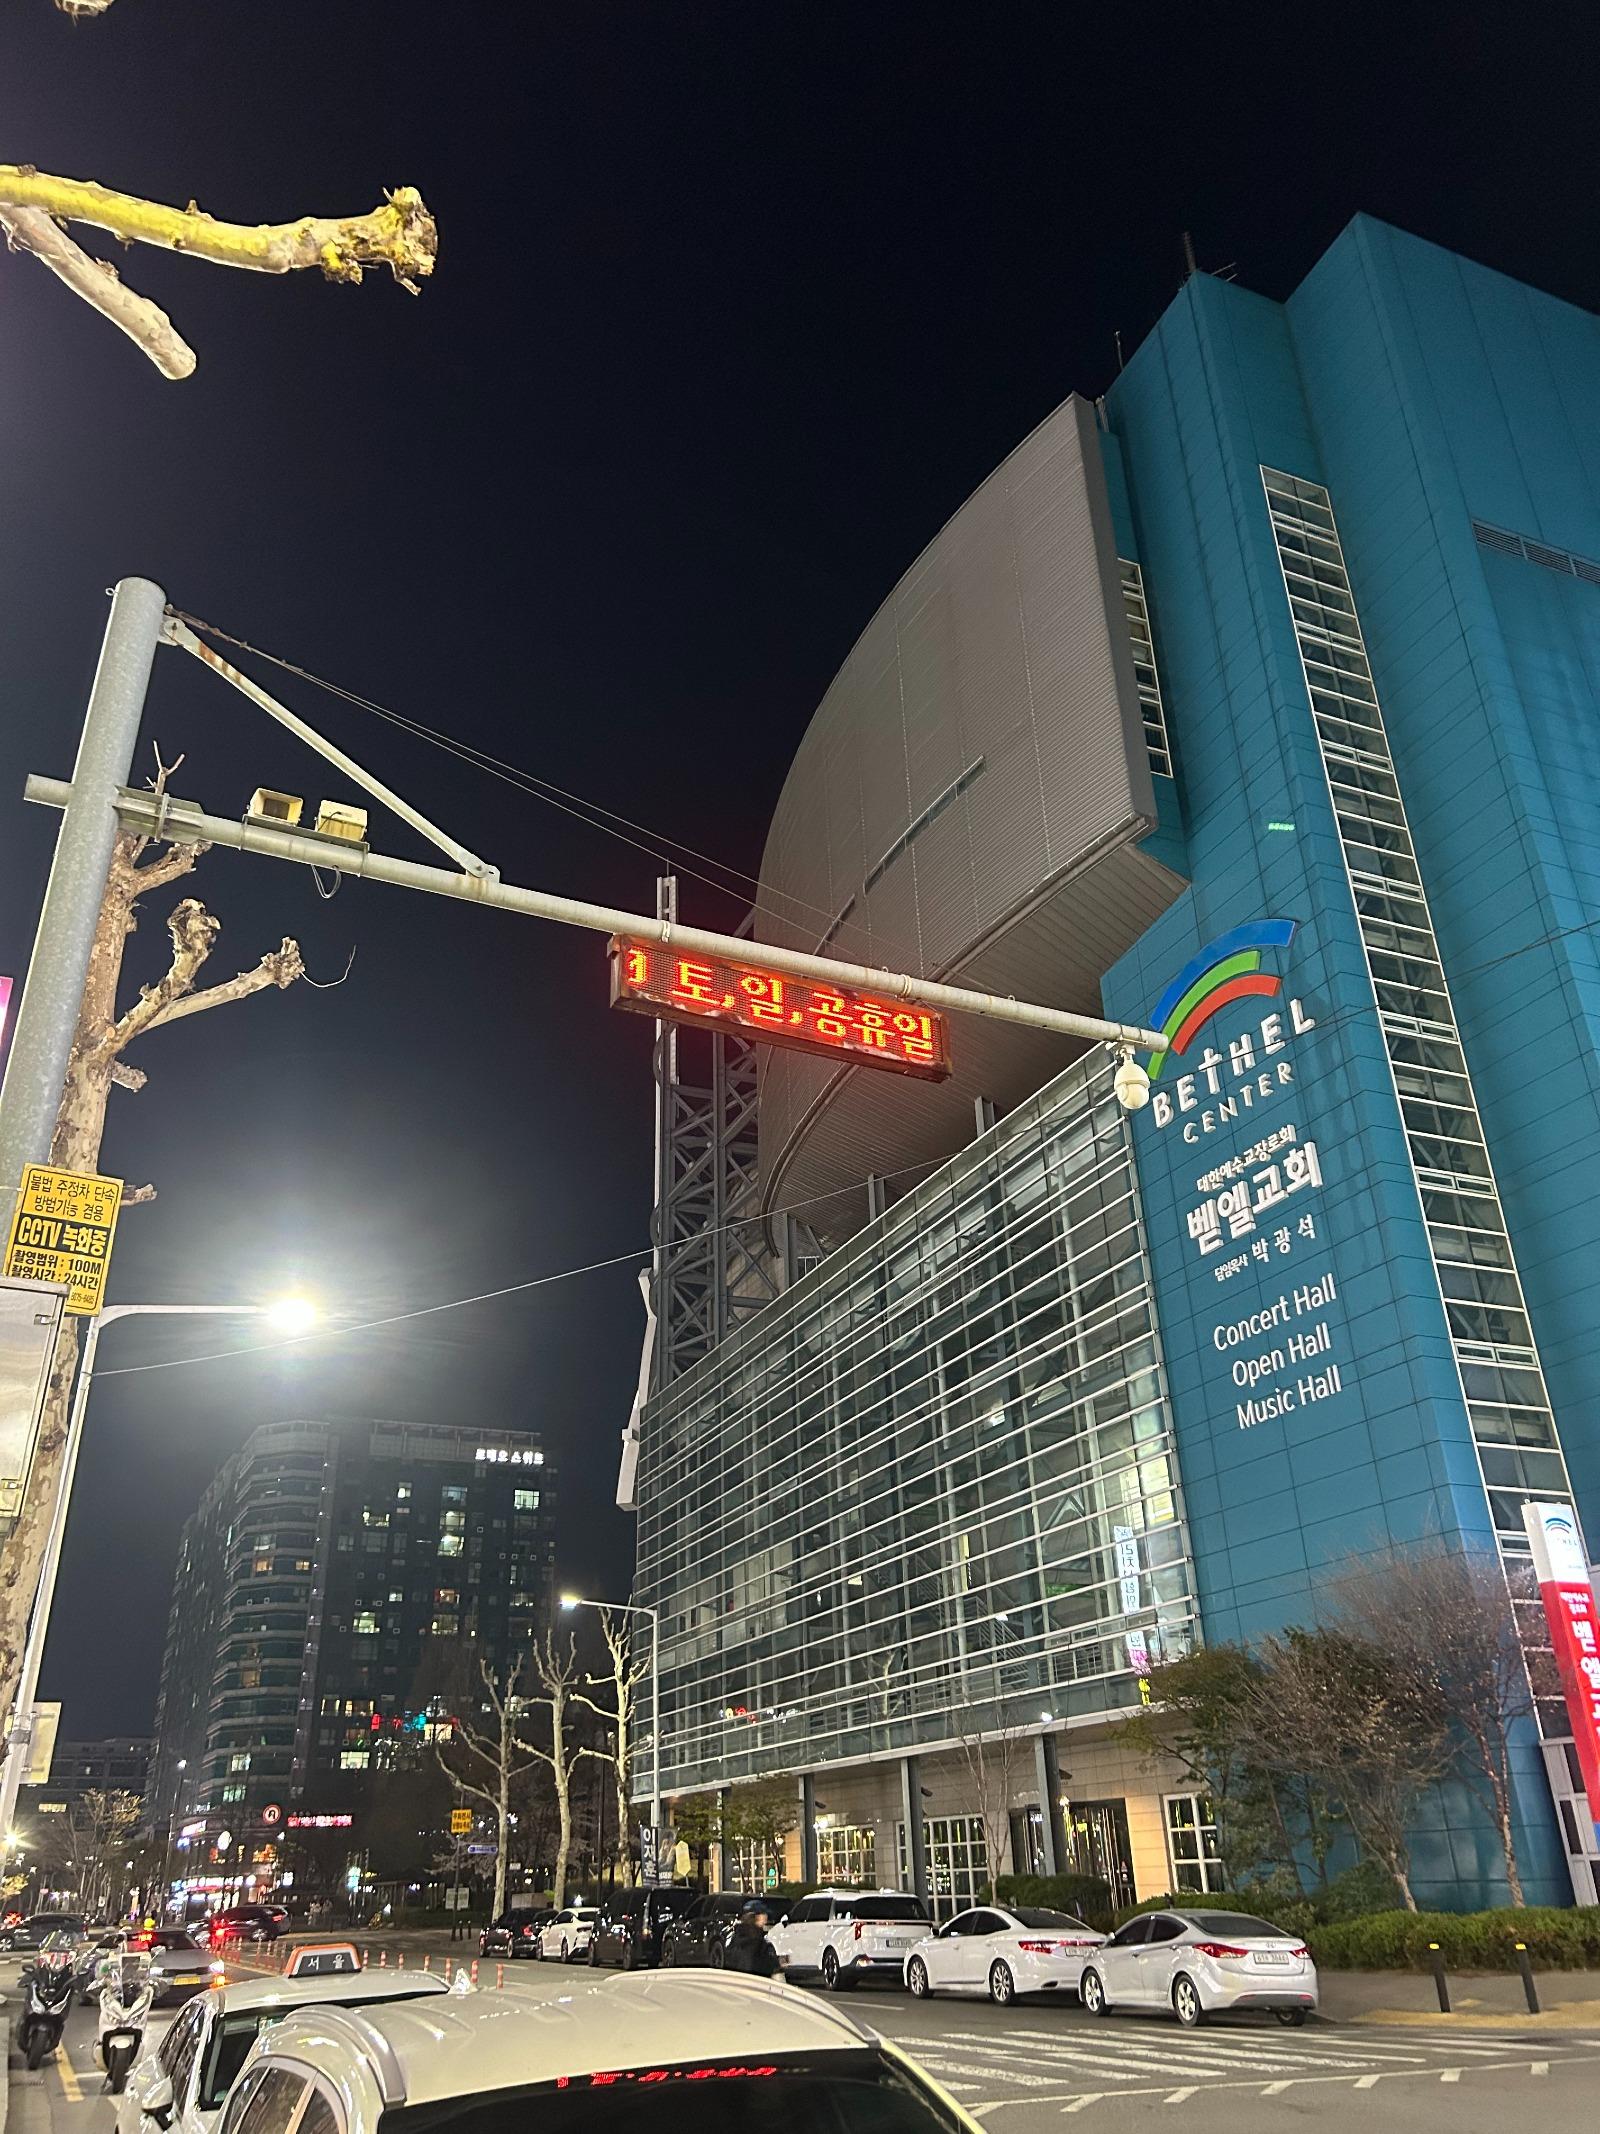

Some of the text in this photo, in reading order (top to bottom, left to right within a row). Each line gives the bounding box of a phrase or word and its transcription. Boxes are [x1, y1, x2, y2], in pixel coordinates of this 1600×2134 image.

[1183, 1062, 1295, 1144] CENTER
[1196, 1124, 1297, 1193] 대한예수교장로회
[31, 1174, 115, 1204] 불법 주정차 단속
[34, 1195, 104, 1221] 방범기능 겸용
[1186, 1141, 1323, 1256] 벧엘교회
[14, 1249, 59, 1269] 촬영범위
[68, 1258, 102, 1275] 100M
[18, 1216, 108, 1256] CCTV 녹화중
[64, 1272, 98, 1290] 24시간
[1214, 1253, 1249, 1282] 담임목사
[1213, 1272, 1337, 1351] Concert Hall
[1232, 1322, 1332, 1388] Open Hall
[1236, 1364, 1342, 1430] Music Hall
